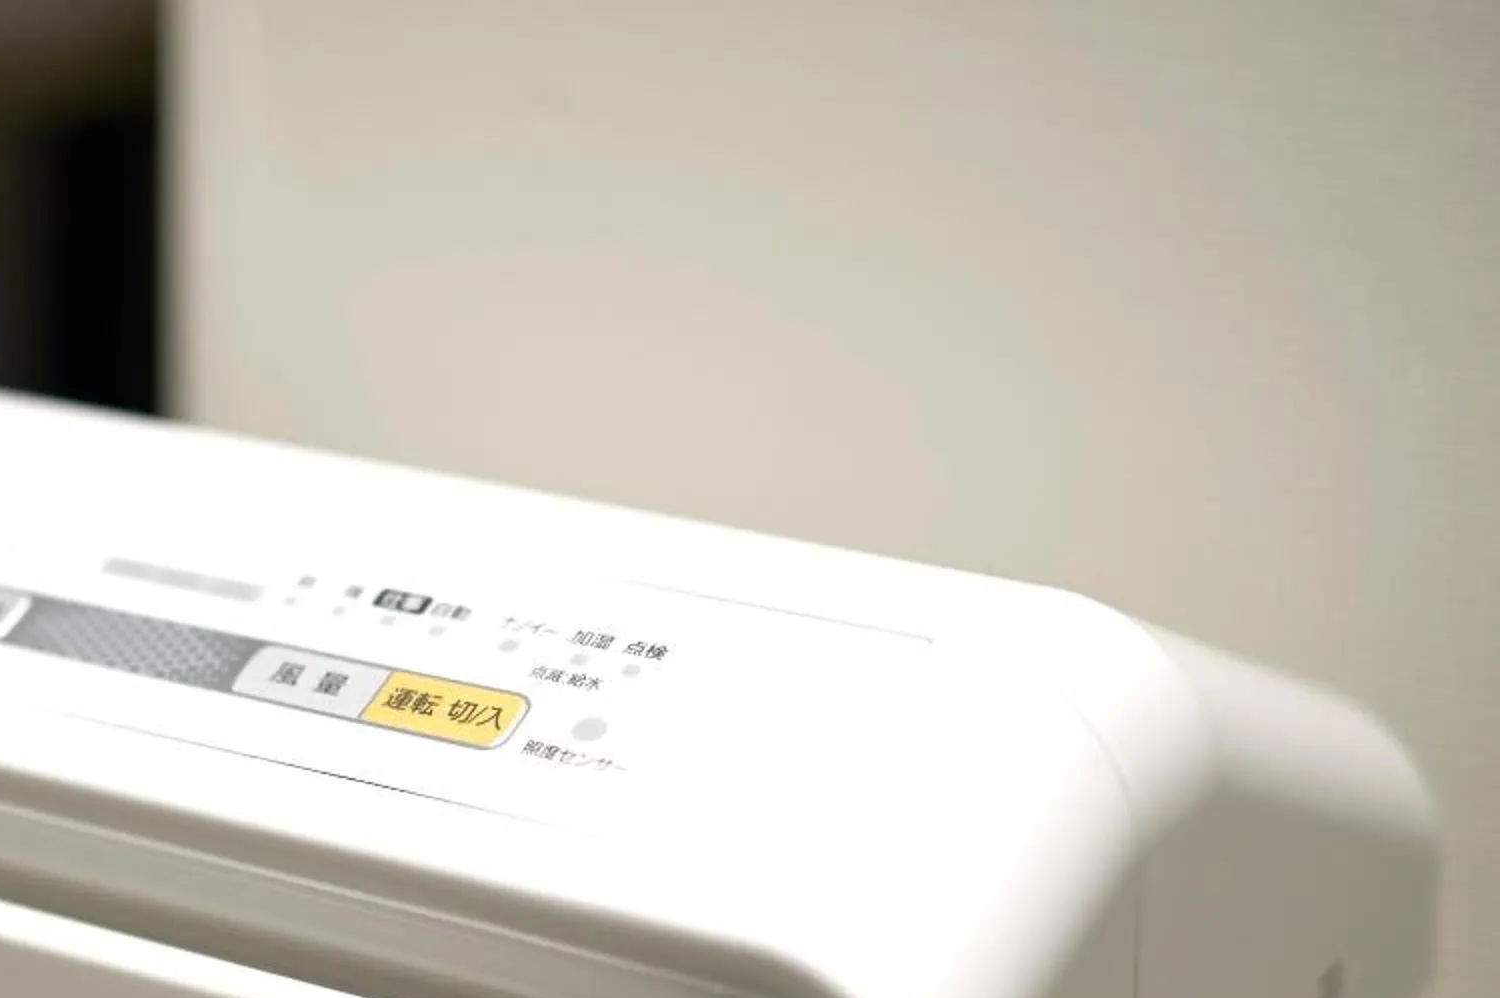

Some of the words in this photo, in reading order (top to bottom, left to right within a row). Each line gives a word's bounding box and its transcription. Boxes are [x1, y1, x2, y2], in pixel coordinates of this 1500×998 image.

[622, 641, 669, 660] 点検
[380, 687, 445, 716] 運転
[447, 699, 504, 730] 切/入
